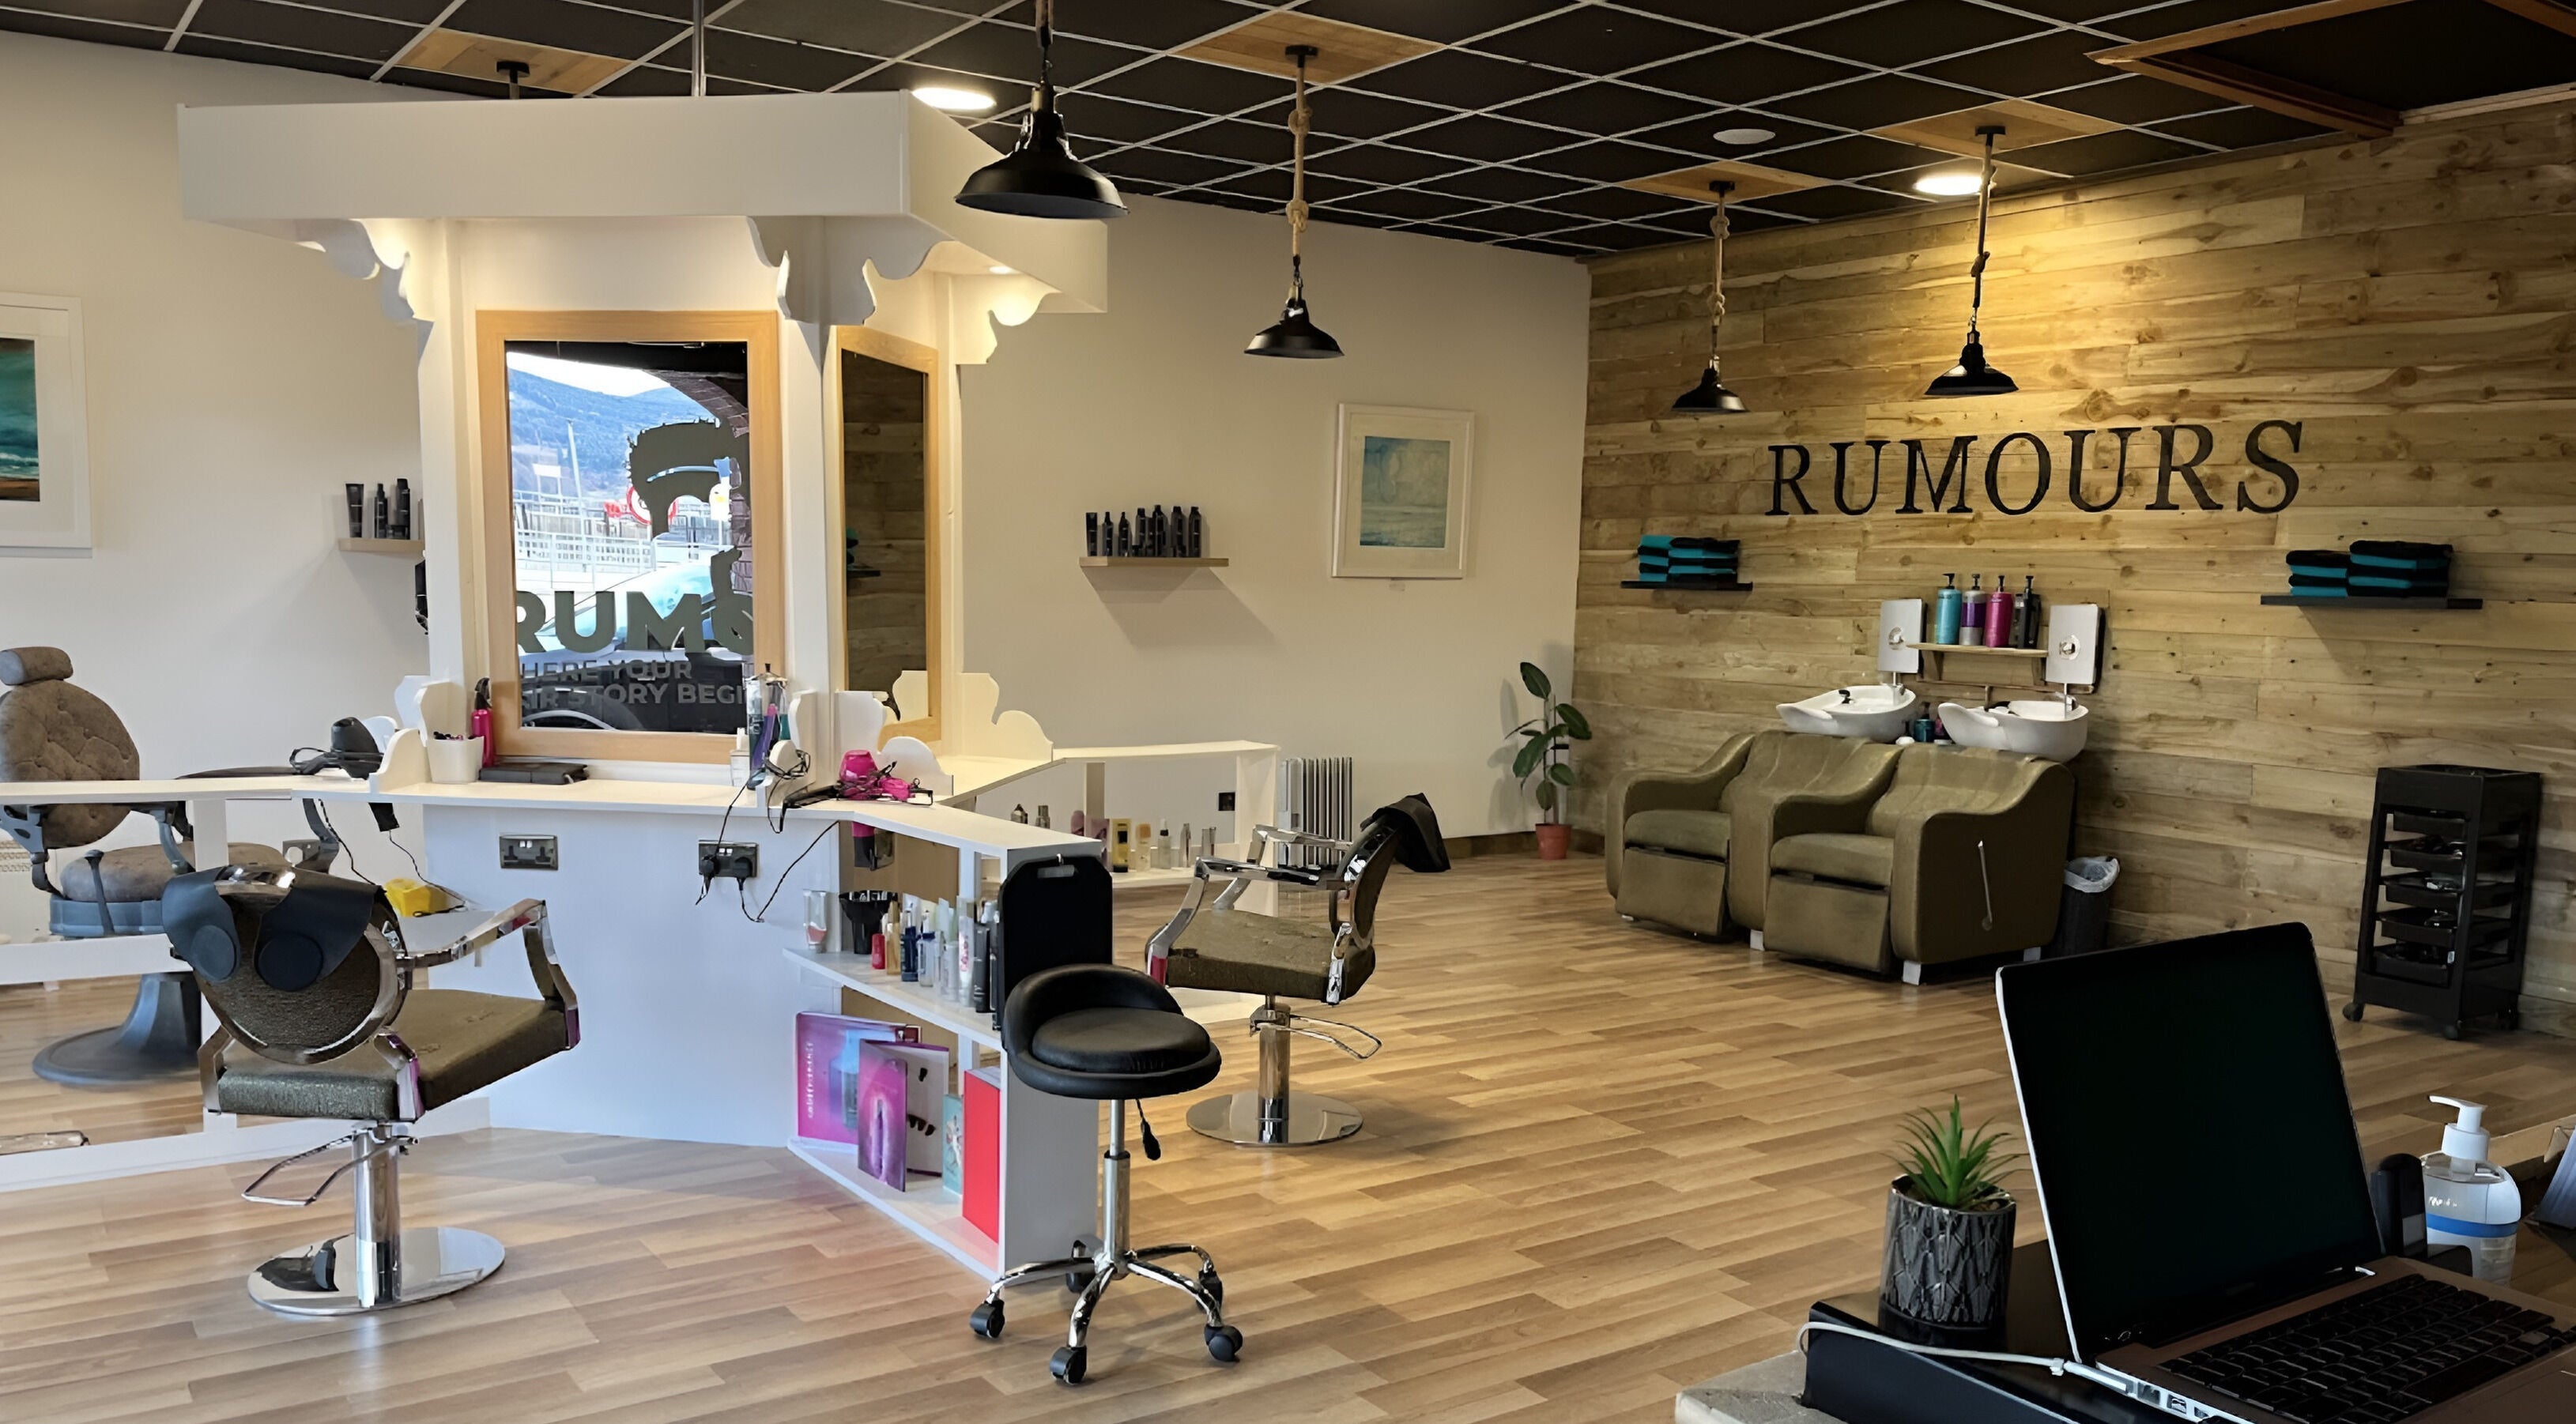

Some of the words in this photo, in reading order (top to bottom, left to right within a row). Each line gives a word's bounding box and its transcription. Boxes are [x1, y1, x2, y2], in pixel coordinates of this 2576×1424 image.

[1764, 420, 2303, 516] RUMOURS
[519, 659, 598, 684] HERE
[608, 659, 693, 680] YOUR
[567, 683, 670, 706] STORY
